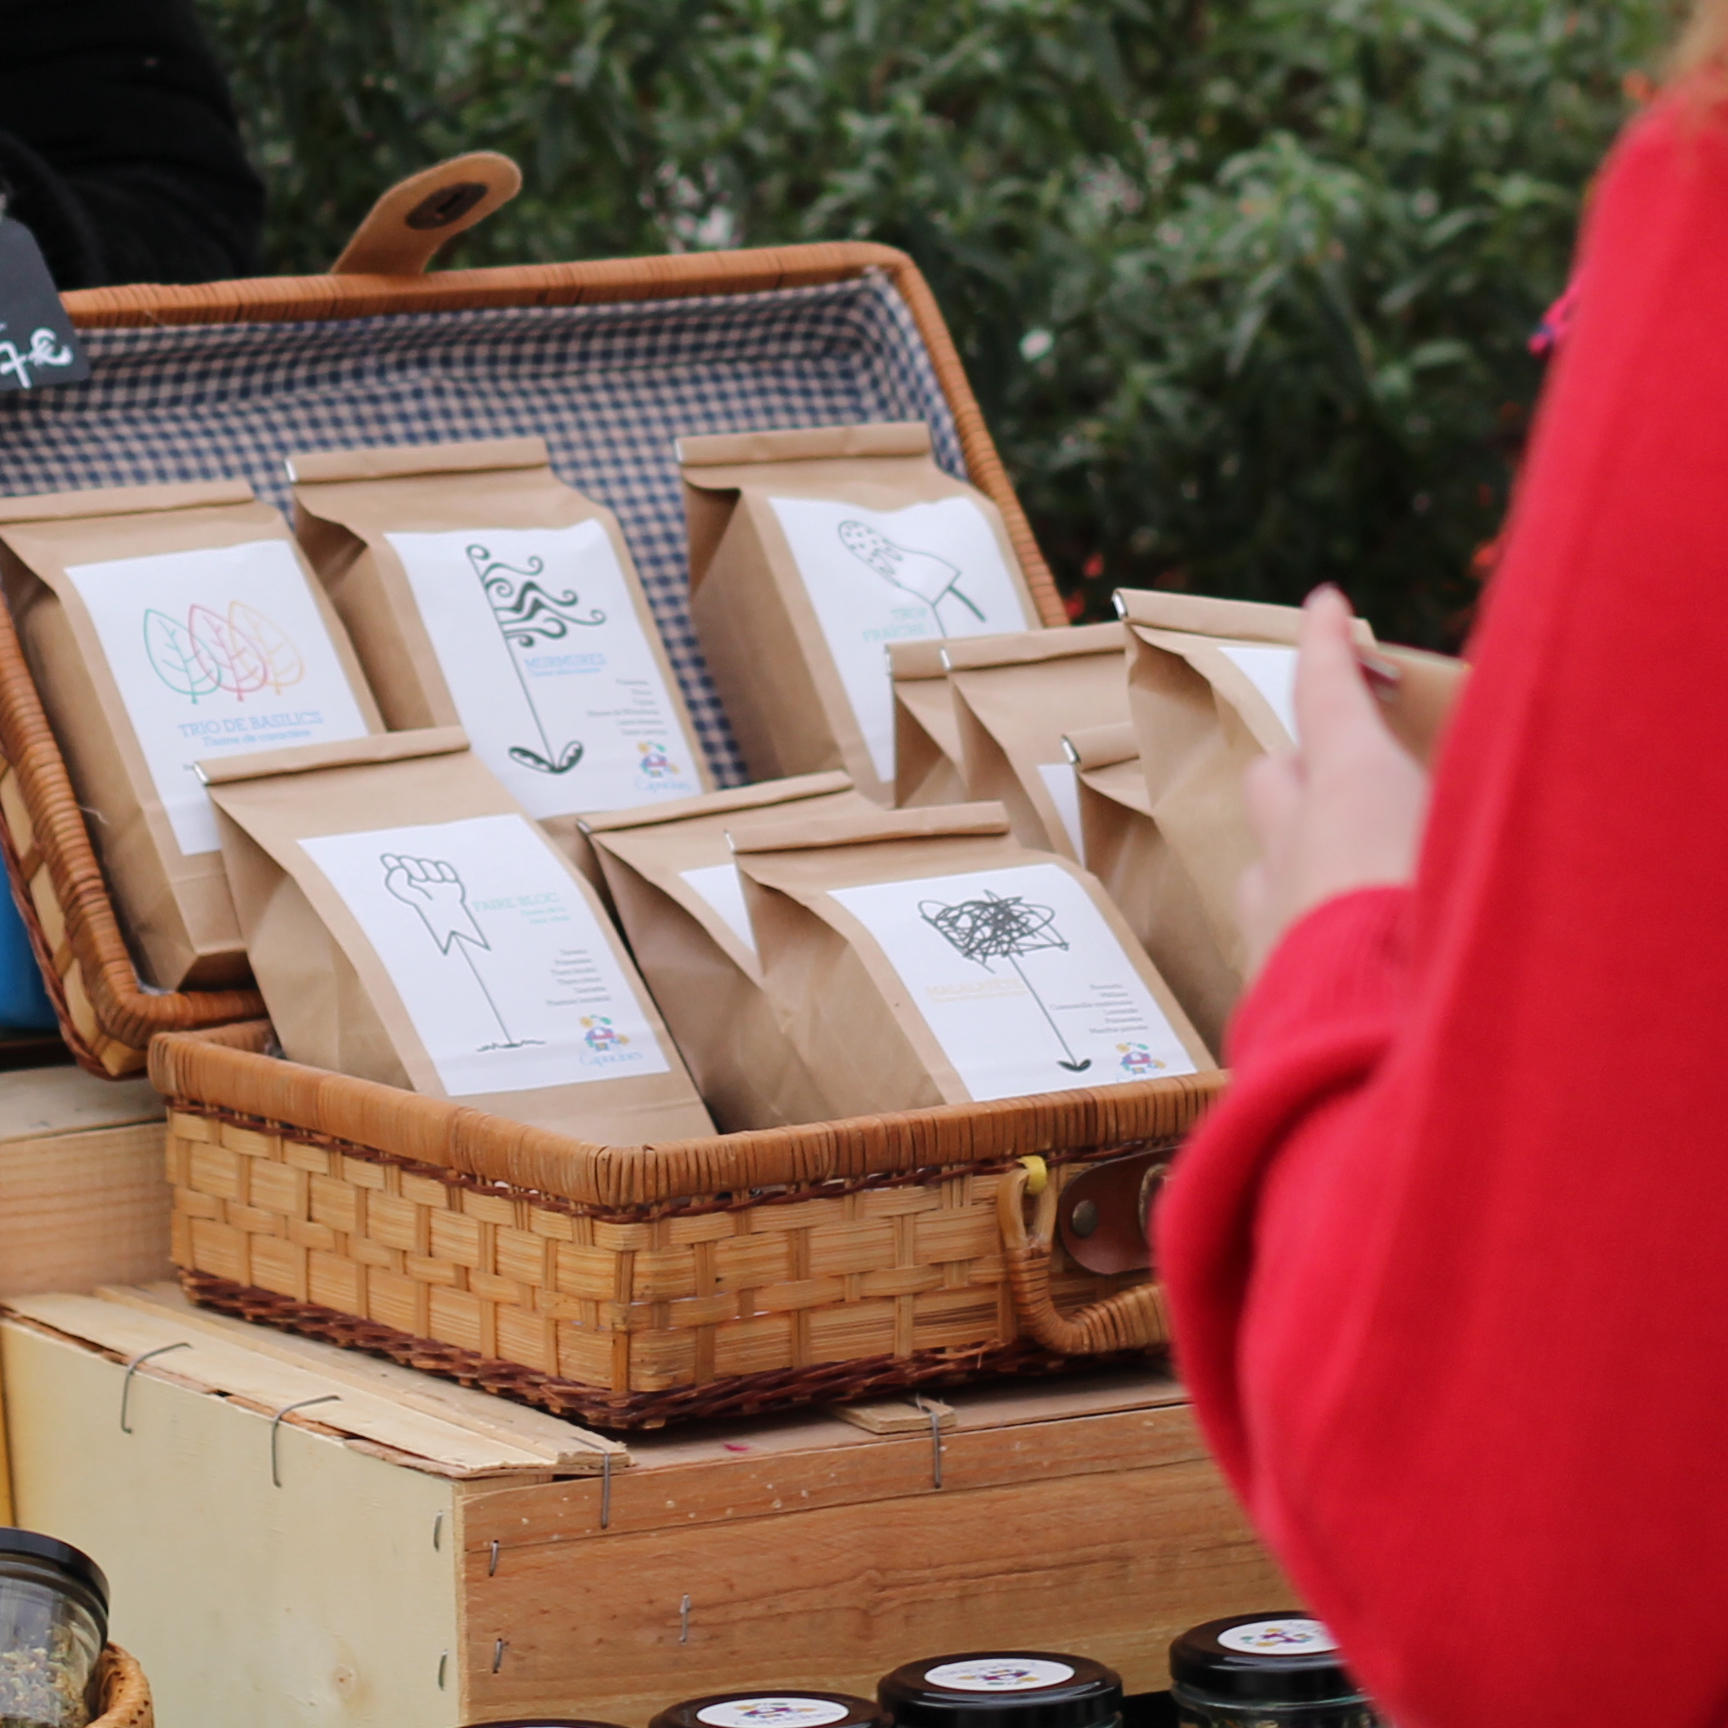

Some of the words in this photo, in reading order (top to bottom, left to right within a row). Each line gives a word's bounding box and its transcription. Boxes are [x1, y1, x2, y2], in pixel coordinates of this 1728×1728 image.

[177, 720, 221, 738] TRIO
[223, 717, 249, 733] DE
[249, 710, 323, 730] BASILICS
